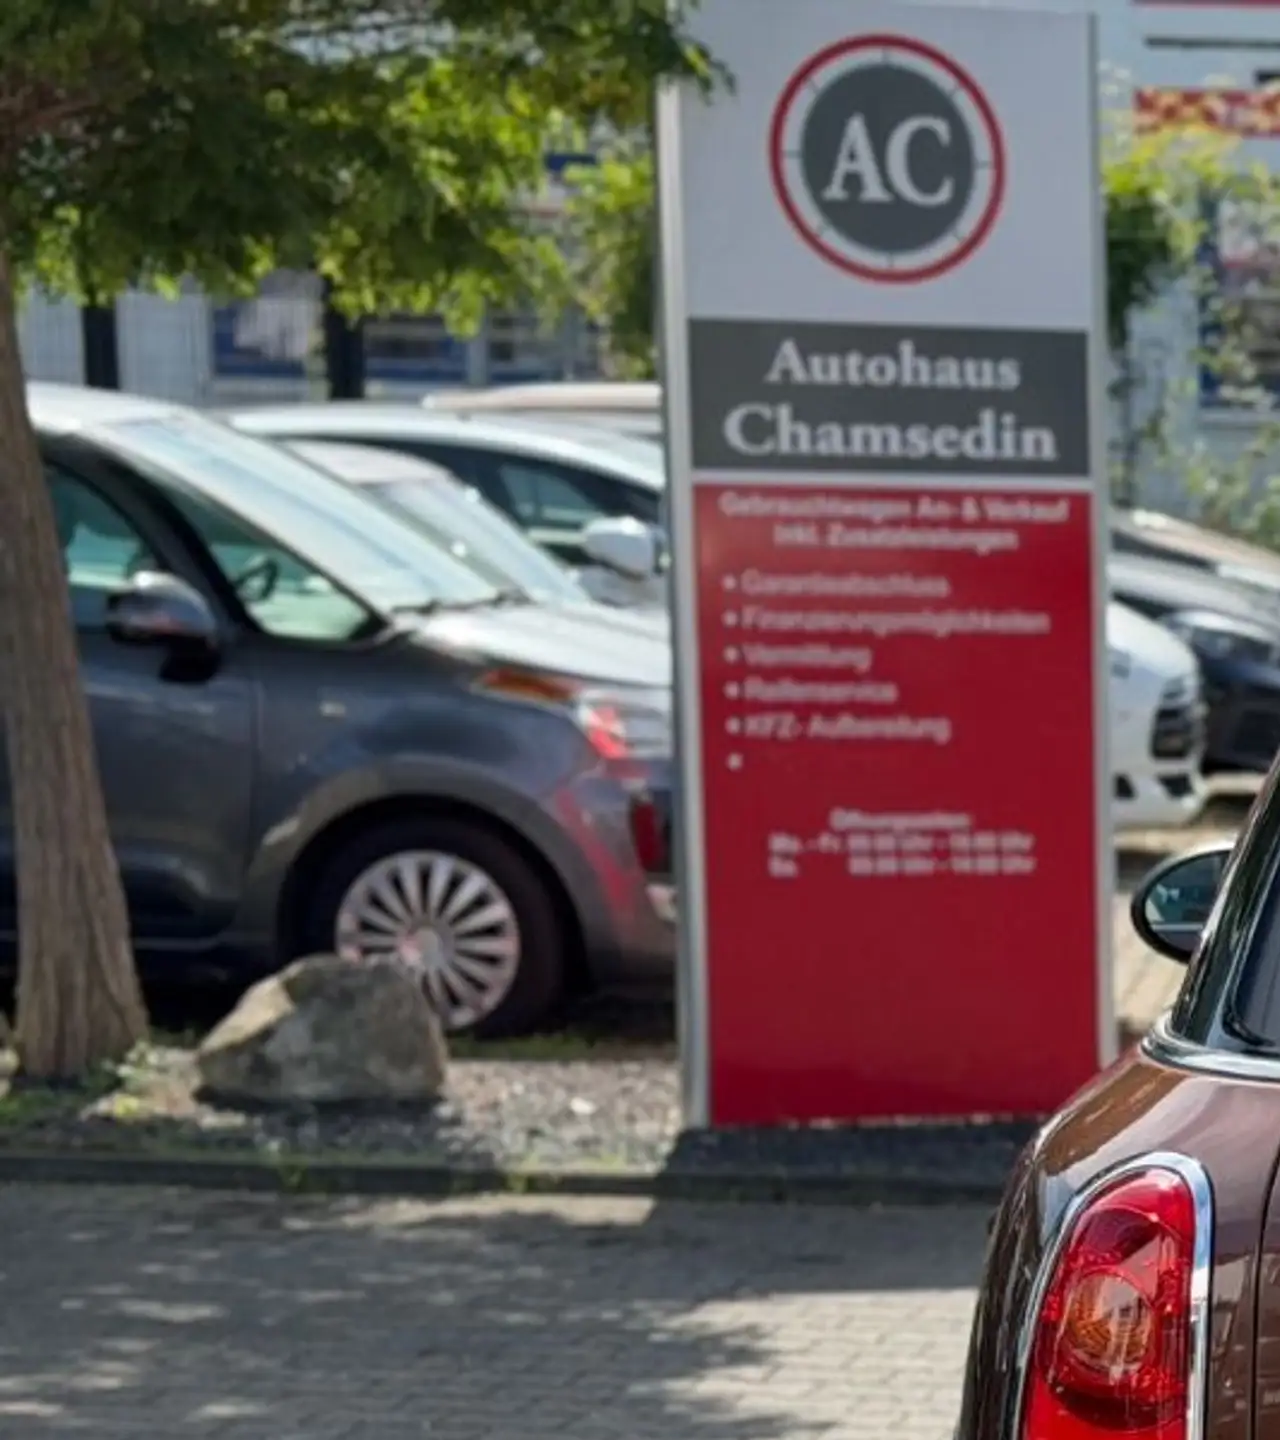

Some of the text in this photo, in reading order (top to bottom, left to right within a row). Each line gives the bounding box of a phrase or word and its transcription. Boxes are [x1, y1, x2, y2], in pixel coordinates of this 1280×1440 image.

[822, 113, 954, 206] AC
[764, 336, 1020, 390] Autohaus
[723, 402, 1057, 461] Chamsedin
